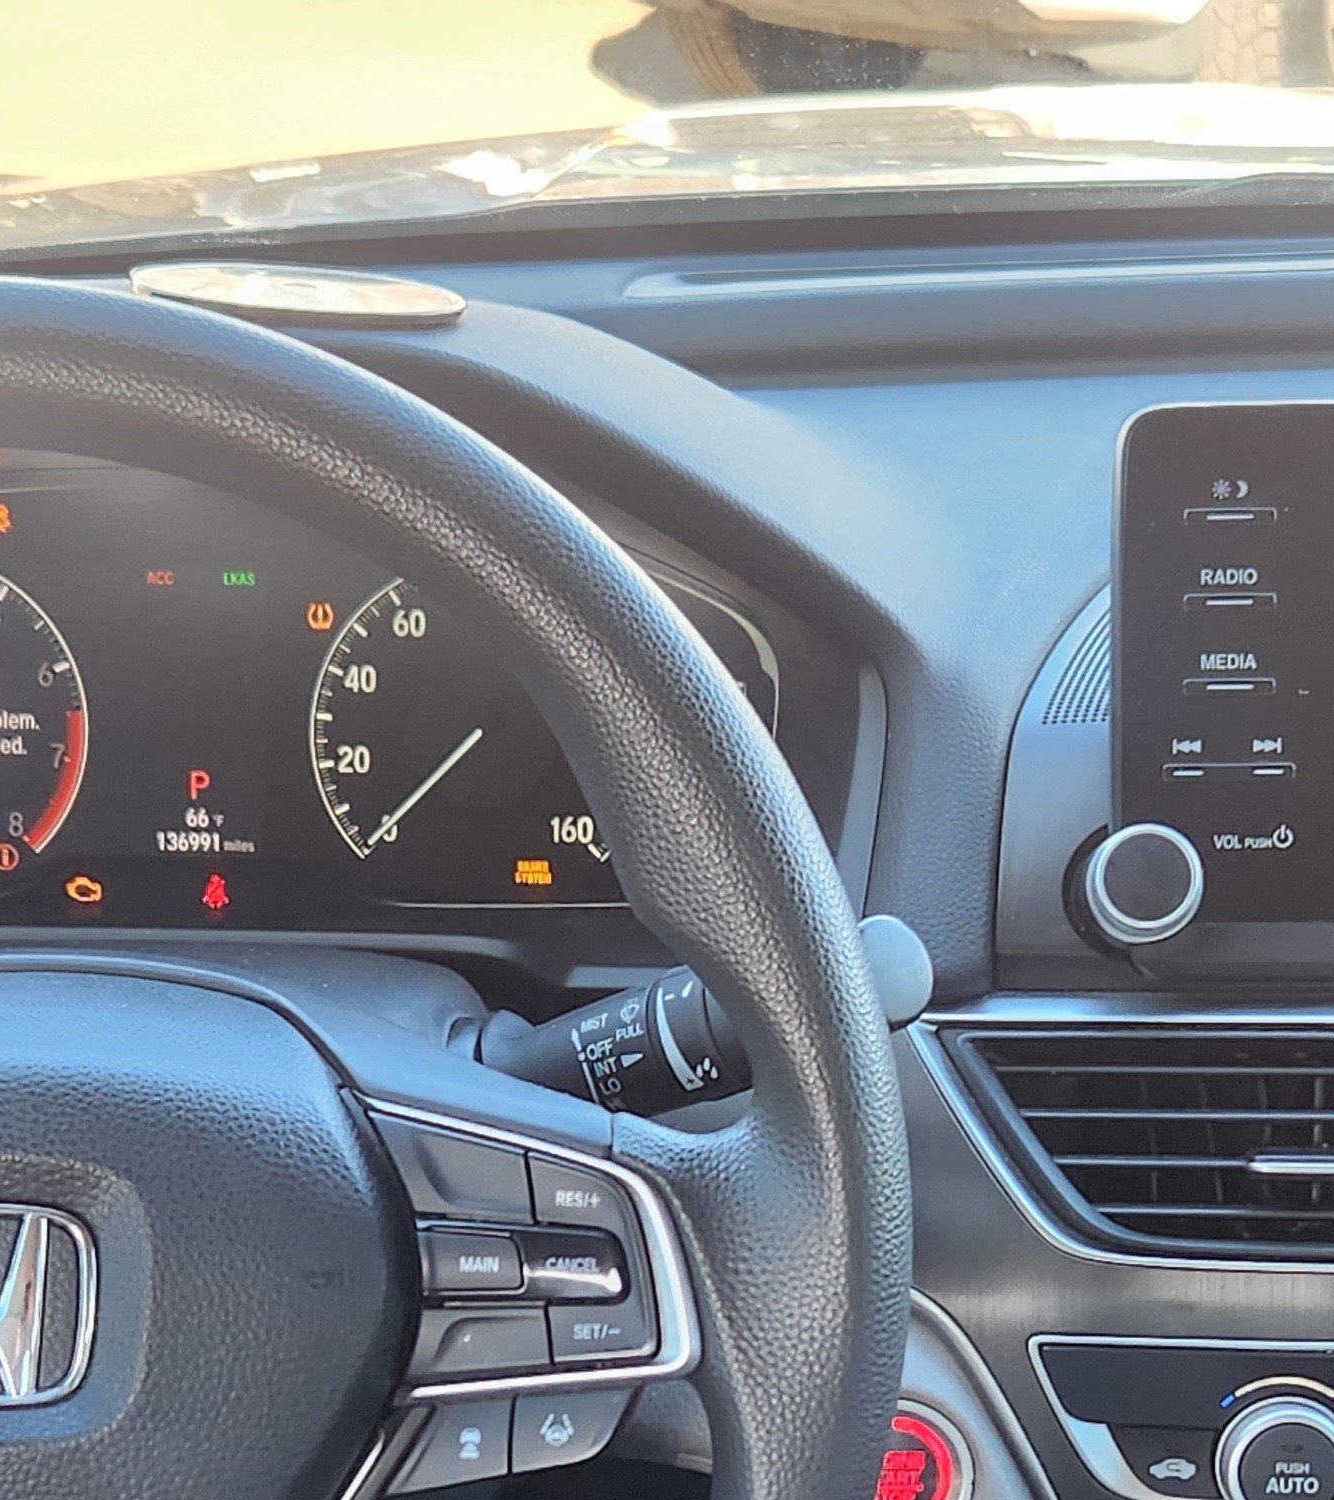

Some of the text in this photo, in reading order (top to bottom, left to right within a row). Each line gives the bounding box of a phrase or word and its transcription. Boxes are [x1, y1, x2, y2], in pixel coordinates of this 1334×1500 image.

[146, 571, 175, 585] ACC
[222, 572, 255, 587] LKAS
[1200, 568, 1258, 585] RADIO
[392, 609, 426, 638] 60
[1200, 653, 1257, 671] MEDIA
[38, 662, 54, 687] 6
[343, 665, 377, 693] 40
[50, 743, 64, 769] 7
[336, 745, 371, 774] 20
[188, 769, 211, 800] P
[9, 812, 23, 837] 8
[186, 807, 210, 828] 66
[550, 815, 595, 844] 160
[156, 831, 220, 852] 136991
[1213, 834, 1273, 850] VOL PUSH
[580, 1012, 609, 1034] MIST
[615, 1022, 645, 1042] PULL
[586, 1037, 614, 1061] OFF
[593, 1056, 617, 1079] INT
[599, 1077, 622, 1096] LO
[555, 1190, 601, 1208] RES/+
[459, 1255, 500, 1273] MAIN
[545, 1256, 600, 1271] CANCEL
[1275, 1462, 1310, 1475] PUSH
[1266, 1477, 1320, 1494] AUTO
